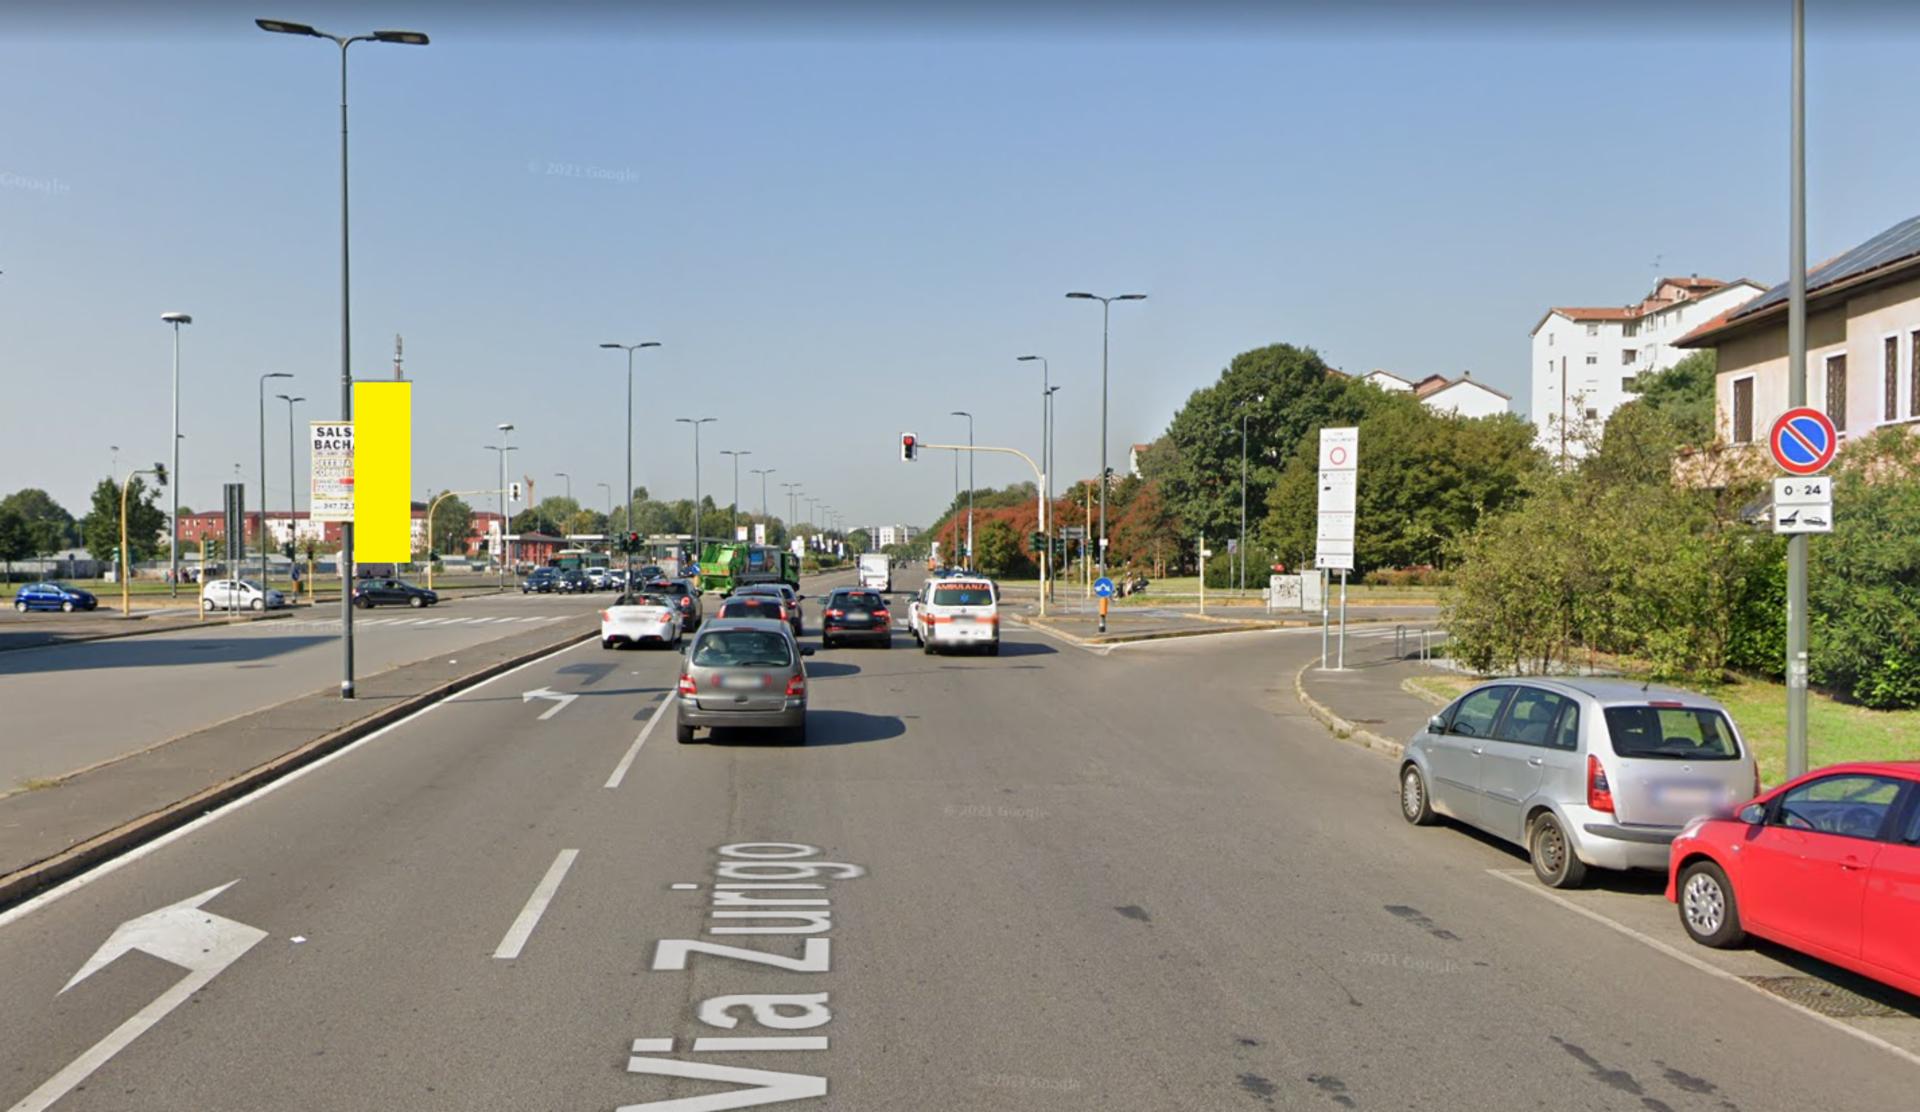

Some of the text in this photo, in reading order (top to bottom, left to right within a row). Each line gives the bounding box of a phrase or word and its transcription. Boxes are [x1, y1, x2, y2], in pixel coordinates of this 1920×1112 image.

[1804, 485, 1821, 495] 24
[614, 842, 864, 1112] Via Zurigo
